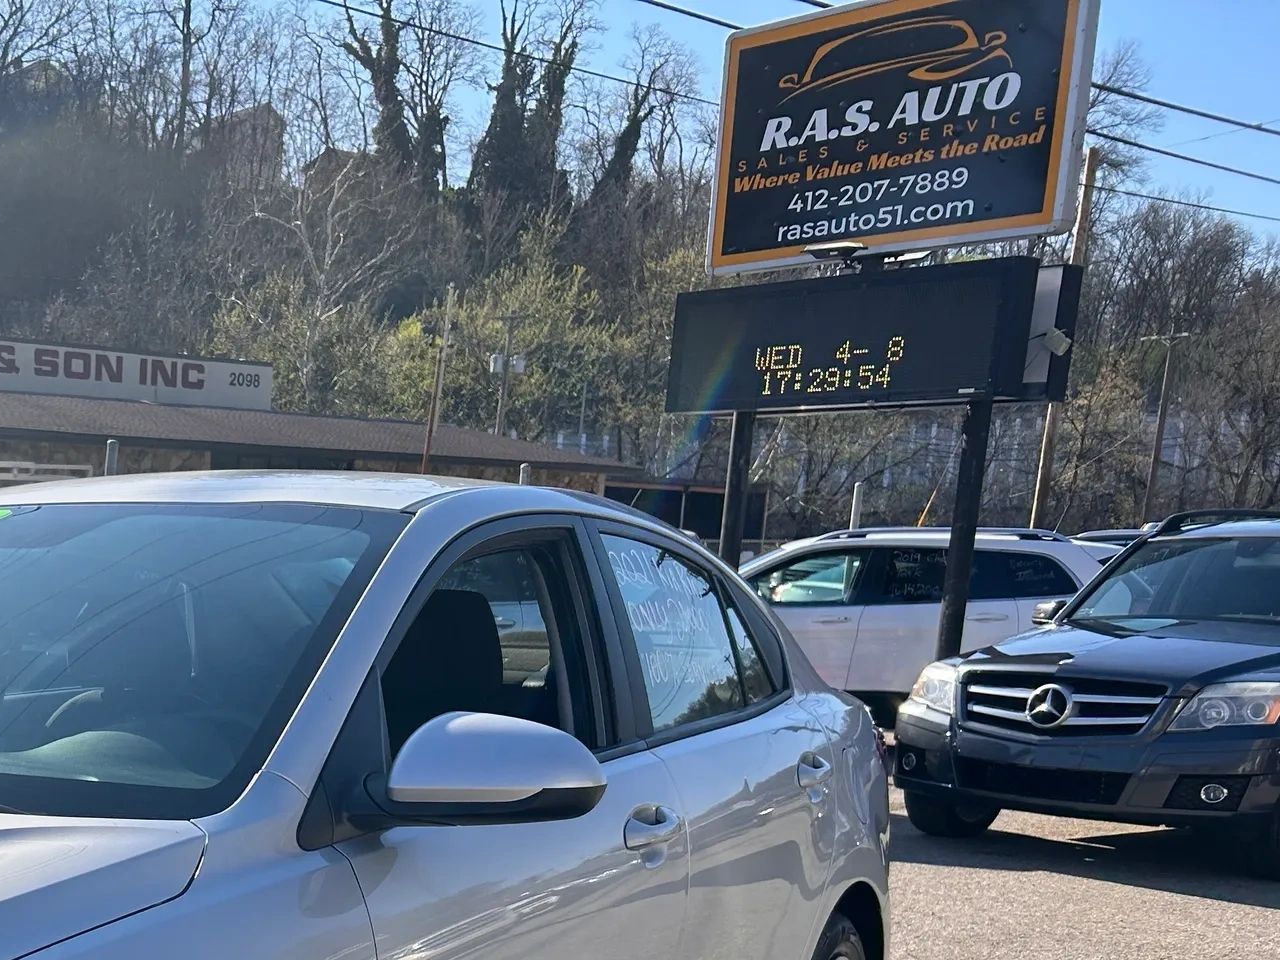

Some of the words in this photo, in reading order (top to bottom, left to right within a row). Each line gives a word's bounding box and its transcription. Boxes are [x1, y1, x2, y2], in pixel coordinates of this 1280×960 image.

[759, 100, 880, 152] R.A.S.
[887, 71, 1022, 129] AUTO
[734, 171, 800, 193] Where
[805, 160, 862, 182] Value
[866, 147, 935, 172] Meets
[940, 139, 980, 160] the
[982, 125, 1046, 153] Road
[737, 145, 829, 173] SALES
[856, 139, 869, 152] &
[898, 106, 1047, 144] SERVICE
[787, 167, 969, 214] 412-207-7889
[776, 198, 975, 242] rasauto51.com
[33, 348, 124, 383] SON
[139, 357, 206, 390] INC
[754, 344, 802, 371] WED
[887, 336, 905, 361] 8
[229, 371, 261, 389] 2098
[761, 363, 891, 395] 17:29:54
